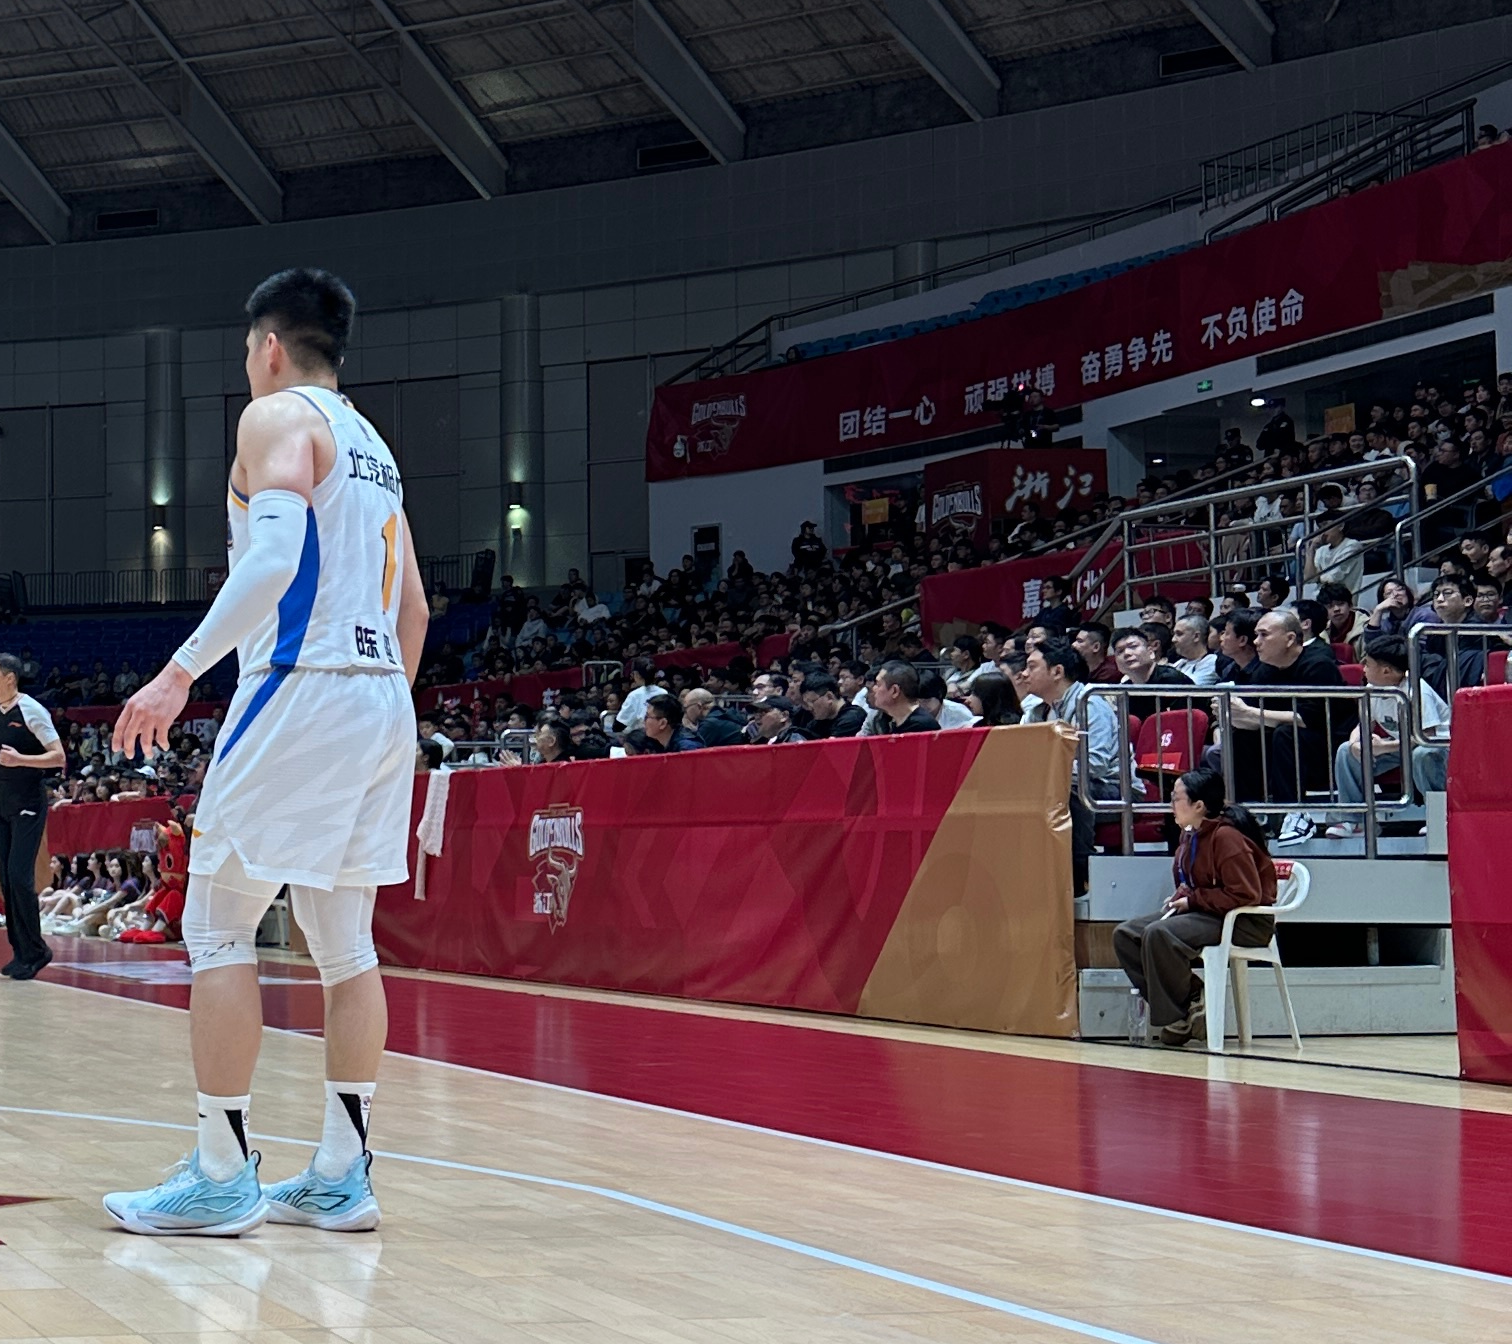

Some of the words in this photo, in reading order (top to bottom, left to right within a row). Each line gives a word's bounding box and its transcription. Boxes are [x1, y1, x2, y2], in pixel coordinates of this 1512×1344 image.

[1200, 287, 1305, 351] 不负使命
[1080, 328, 1174, 387] 奋勇争先
[839, 395, 937, 443] 团结一心
[347, 447, 402, 498] 北汽
[1005, 463, 1095, 512] 浙江
[1021, 567, 1105, 620] 嘉(北)
[1160, 733, 1174, 747] 15
